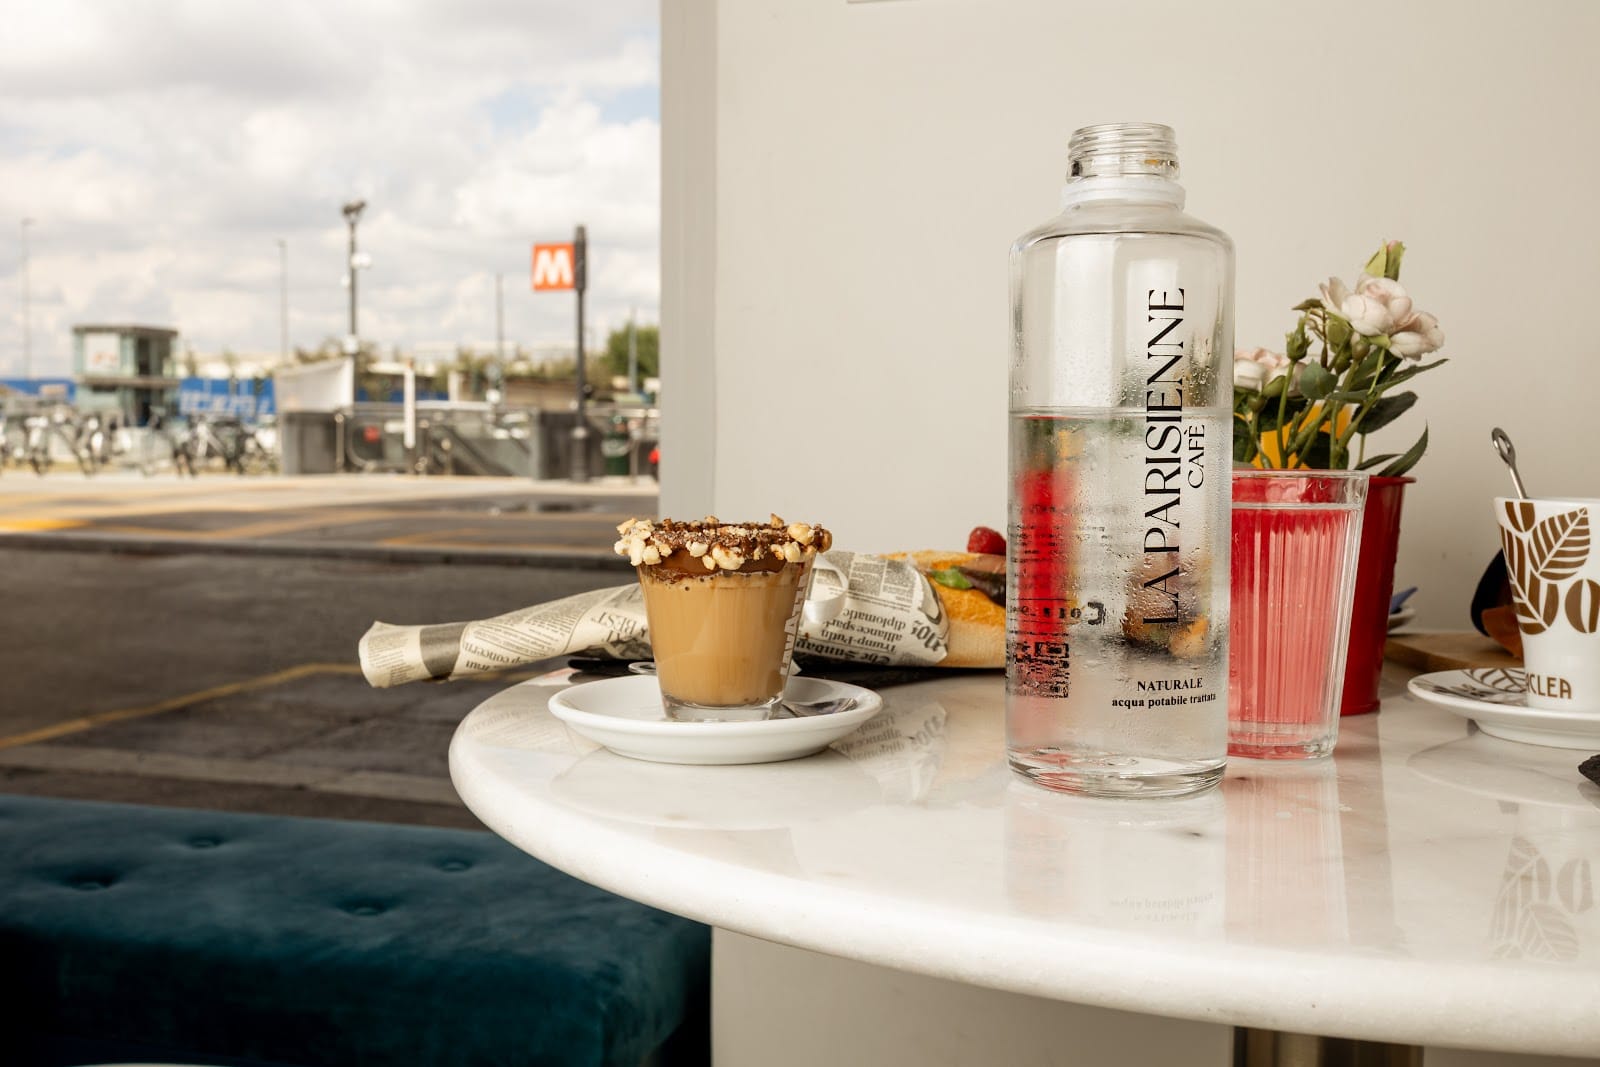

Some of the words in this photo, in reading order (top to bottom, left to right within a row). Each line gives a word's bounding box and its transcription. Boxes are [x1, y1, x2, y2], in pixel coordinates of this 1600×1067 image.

[534, 249, 573, 285] M
[1144, 288, 1185, 554] PARISIENNE
[1143, 567, 1180, 624] LA
[1112, 698, 1144, 709] acqua
[1148, 695, 1187, 708] potabile
[1137, 677, 1203, 691] NATURALE
